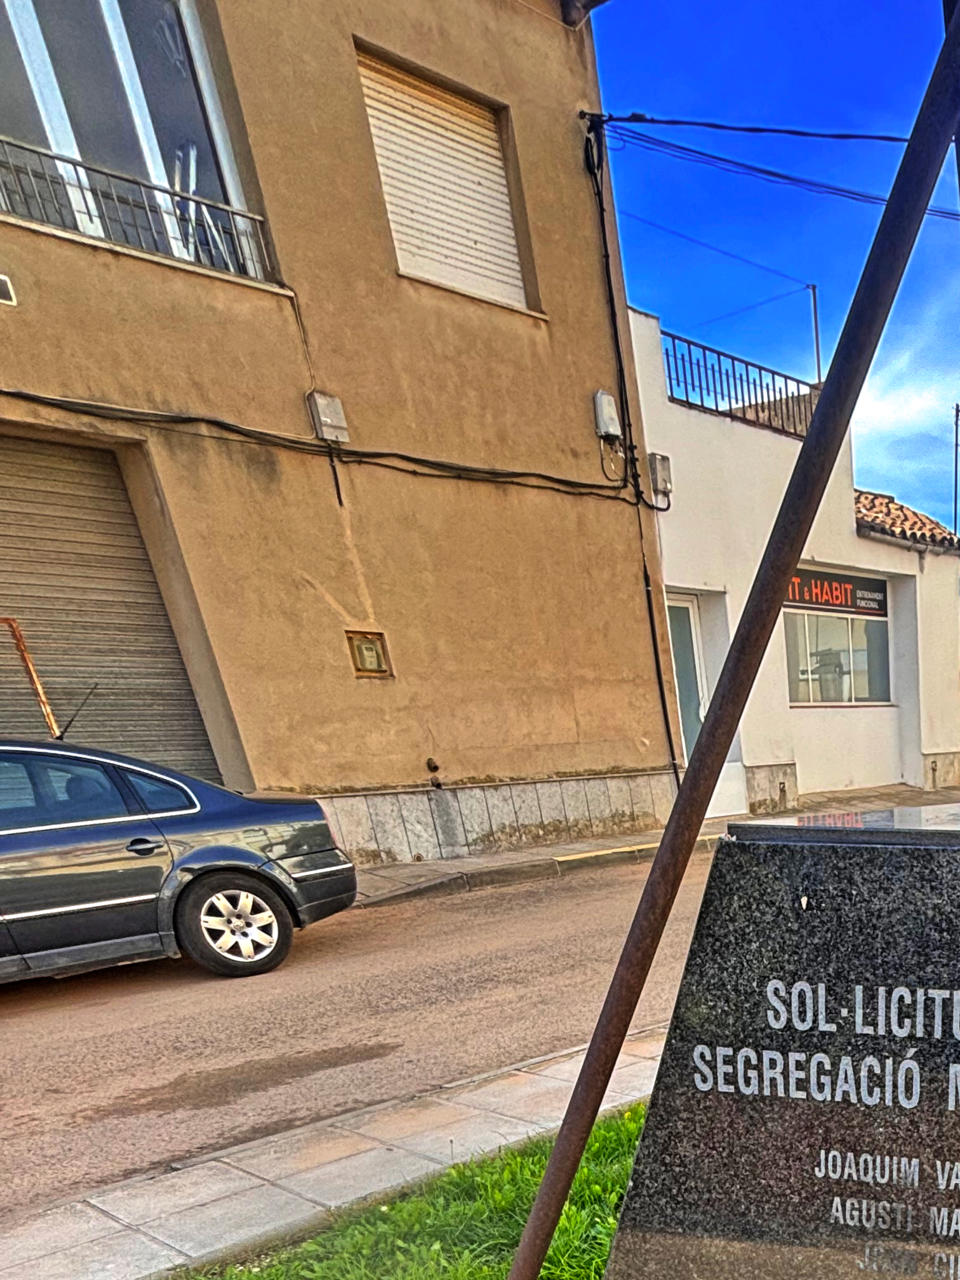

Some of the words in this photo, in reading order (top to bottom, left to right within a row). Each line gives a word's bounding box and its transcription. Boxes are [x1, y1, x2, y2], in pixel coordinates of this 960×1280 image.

[788, 577, 800, 600] IT
[811, 579, 852, 605] HABIT
[693, 1045, 921, 1109] SEGREGACIÓ
[815, 1149, 919, 1189] JOAQUIM
